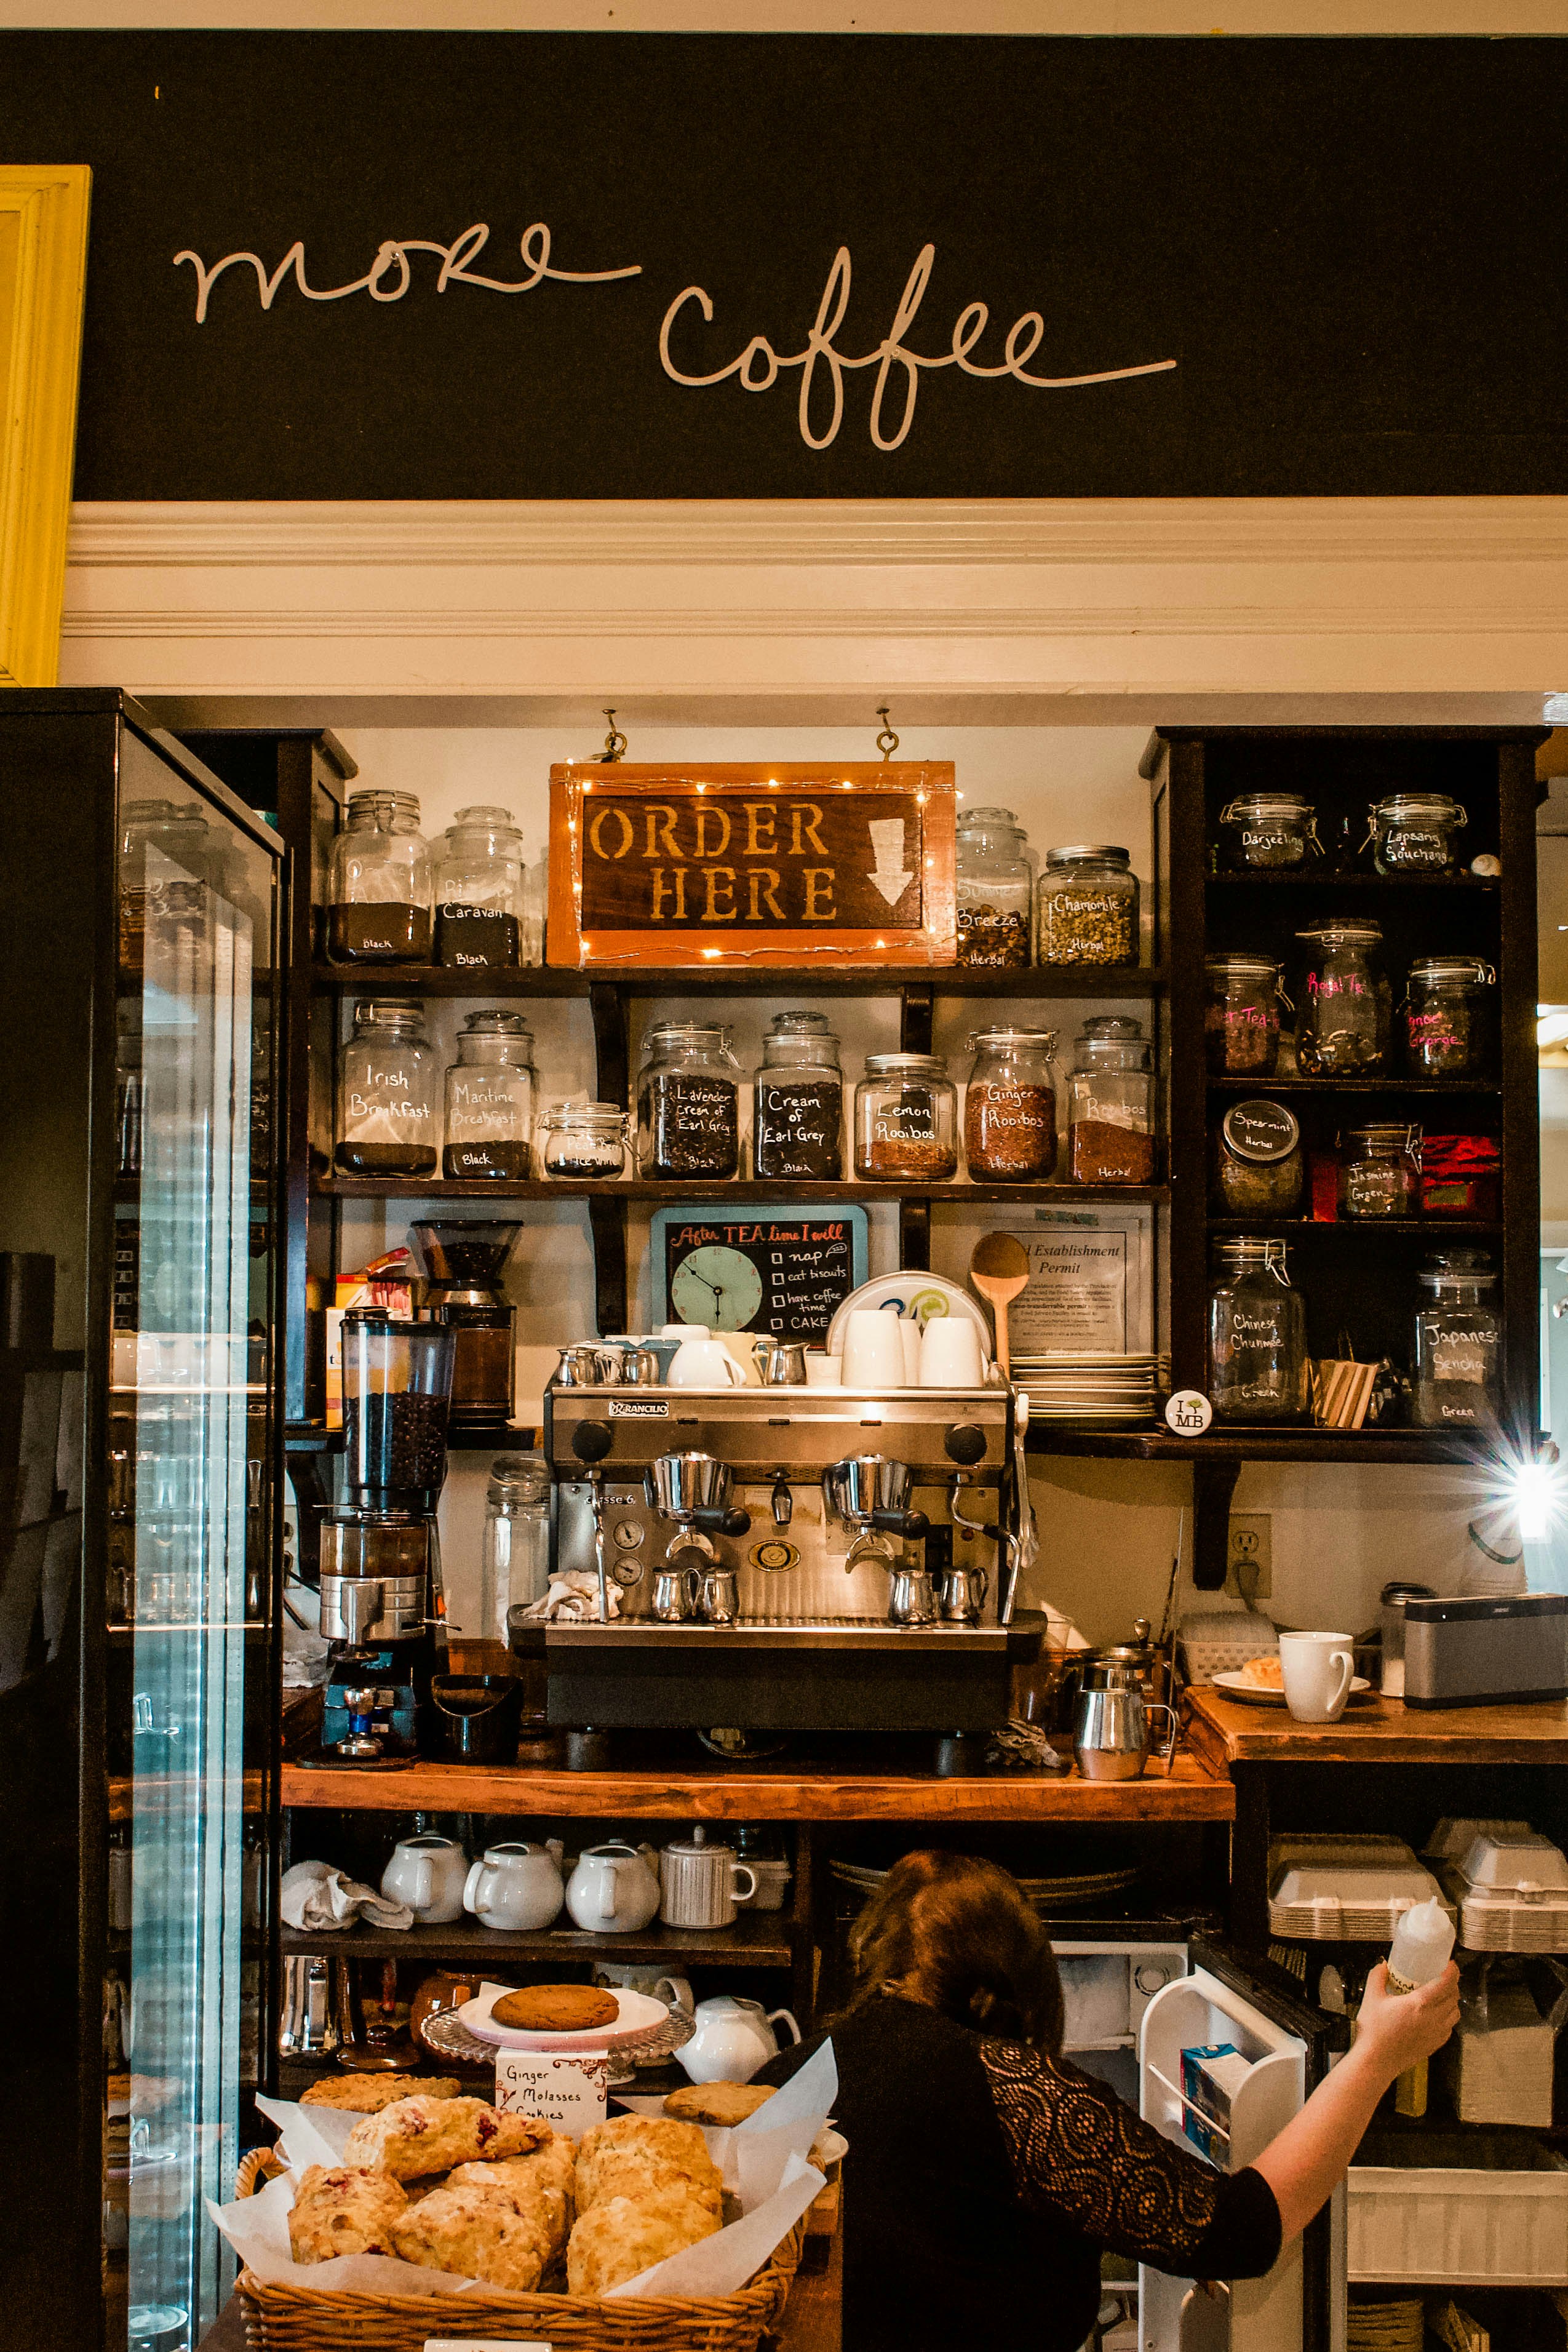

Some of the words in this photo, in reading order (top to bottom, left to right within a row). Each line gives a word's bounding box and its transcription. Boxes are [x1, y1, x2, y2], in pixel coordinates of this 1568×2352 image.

[589, 802, 829, 860] ORDER
[1387, 830, 1440, 848] Lapsang
[650, 866, 837, 921] HERE
[443, 903, 503, 919] Caravan
[1054, 893, 1120, 912] Chamomile
[957, 908, 1019, 928] Breeze
[455, 953, 488, 965] Black
[970, 953, 1005, 966] Herbal
[367, 1064, 409, 1090] Irish
[454, 1082, 516, 1104] Maritime
[677, 1085, 732, 1102] Lavender
[768, 1091, 821, 1110] Cream
[987, 1083, 1034, 1107] Ginger
[351, 1093, 431, 1118] Breakfast
[677, 1106, 709, 1115] Cream
[714, 1106, 726, 1117] of
[877, 1102, 932, 1118] Lemon
[450, 1108, 517, 1126] Breakfast
[788, 1108, 803, 1122] of
[987, 1109, 1044, 1128] Rooibos
[1233, 1112, 1292, 1132] Spearmint
[679, 1118, 705, 1130] Earl
[875, 1121, 936, 1142] Rooibos
[764, 1127, 792, 1144] Earl
[797, 1126, 826, 1146] Grey
[461, 1150, 493, 1165] Black
[670, 1225, 720, 1246] After
[723, 1224, 765, 1243] TEA
[802, 1224, 810, 1242] I
[810, 1223, 845, 1240] will
[788, 1251, 823, 1266] nap
[1034, 1244, 1120, 1256] Establishment
[788, 1269, 807, 1281] eat
[810, 1265, 847, 1279] biscuits
[1038, 1262, 1081, 1274] Permit
[787, 1293, 811, 1304] have
[813, 1288, 842, 1303] coffee
[799, 1303, 827, 1312] time
[1233, 1314, 1276, 1331] Chinese
[1441, 1405, 1475, 1417] Green
[1175, 1414, 1203, 1429] MB
[507, 2065, 549, 2085] Ginger
[523, 2087, 581, 2102] Molasses
